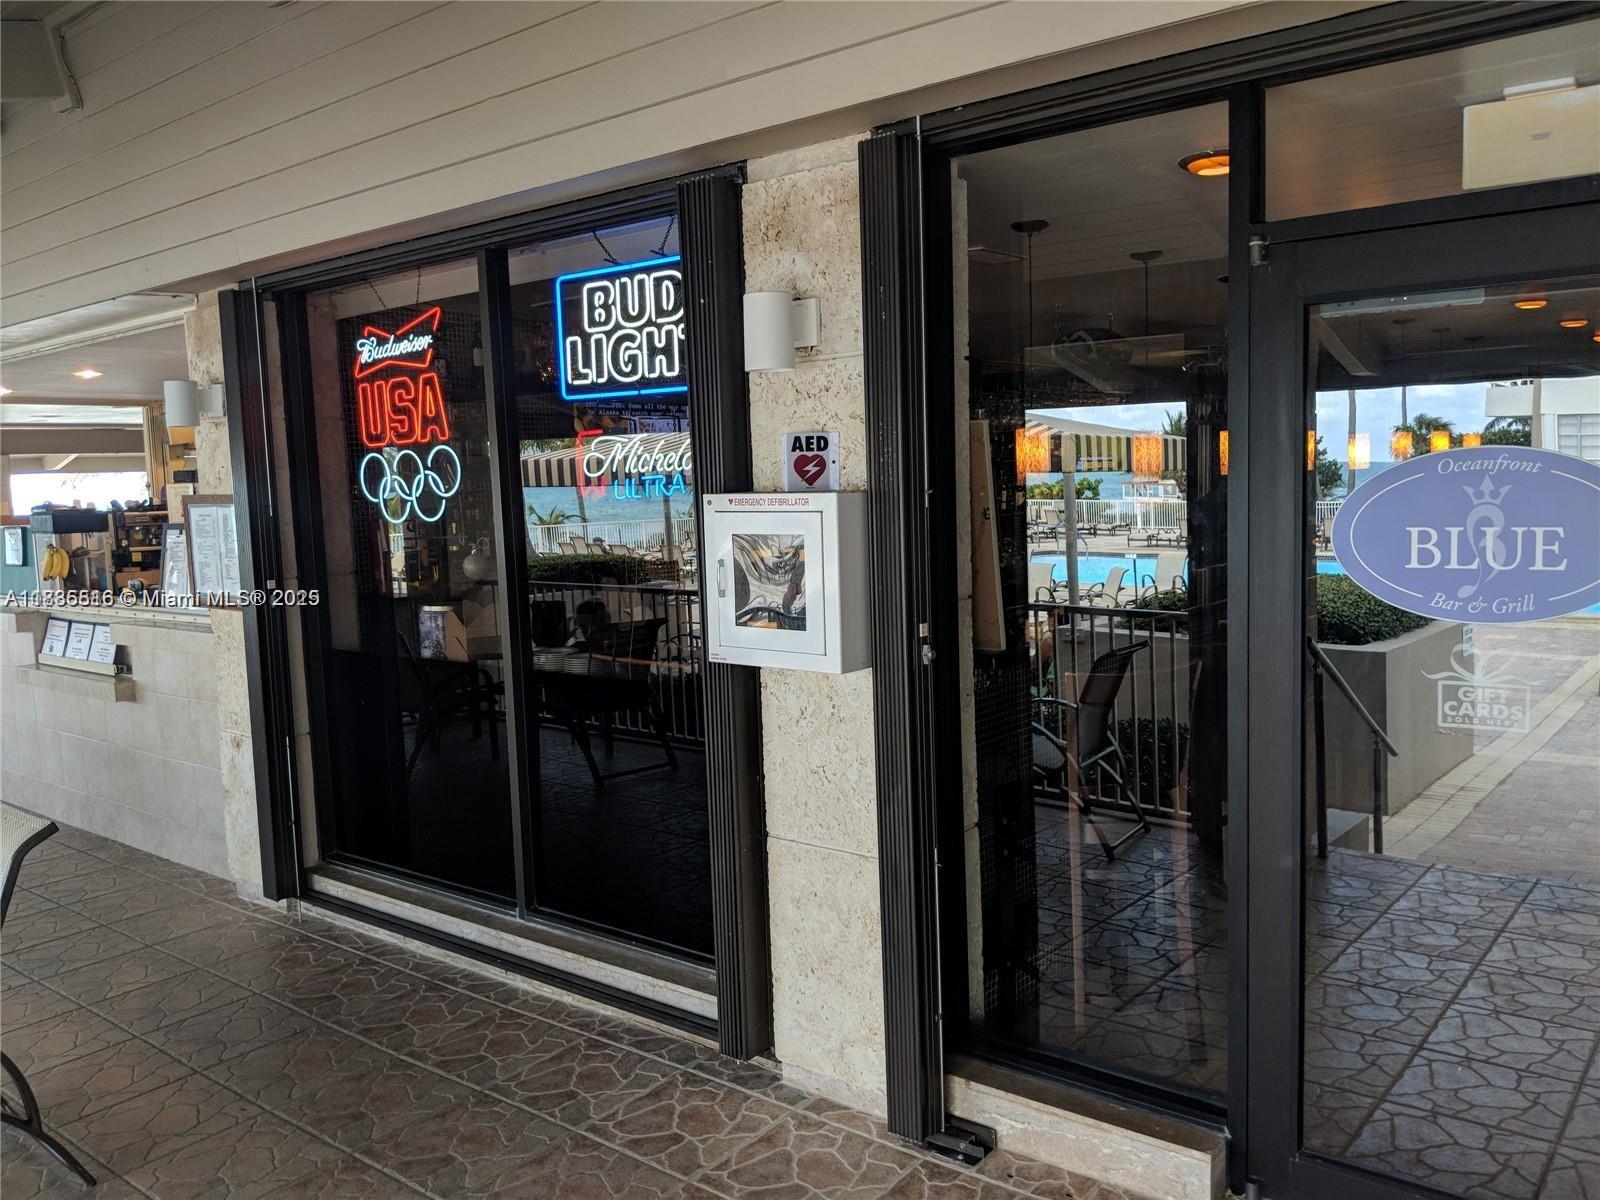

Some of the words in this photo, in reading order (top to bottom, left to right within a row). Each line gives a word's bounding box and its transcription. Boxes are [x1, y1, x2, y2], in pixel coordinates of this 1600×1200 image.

[583, 269, 685, 333] BUD
[356, 333, 434, 364] Budweiser
[565, 323, 686, 385] LIGH
[358, 372, 449, 447] USA
[790, 435, 829, 453] AED
[1437, 453, 1544, 476] Oceanfront
[613, 473, 687, 500] ULTRA
[734, 497, 767, 507] EMERGENCY
[767, 497, 810, 507] DEFIBRILLATOR
[1405, 526, 1568, 571] BLUE
[1428, 591, 1463, 612] Bar
[1467, 596, 1488, 613] &
[1491, 593, 1536, 615] Grill
[1457, 686, 1511, 703] GIFT
[1443, 700, 1524, 720] CARDS
[1446, 716, 1480, 724] SOLD
